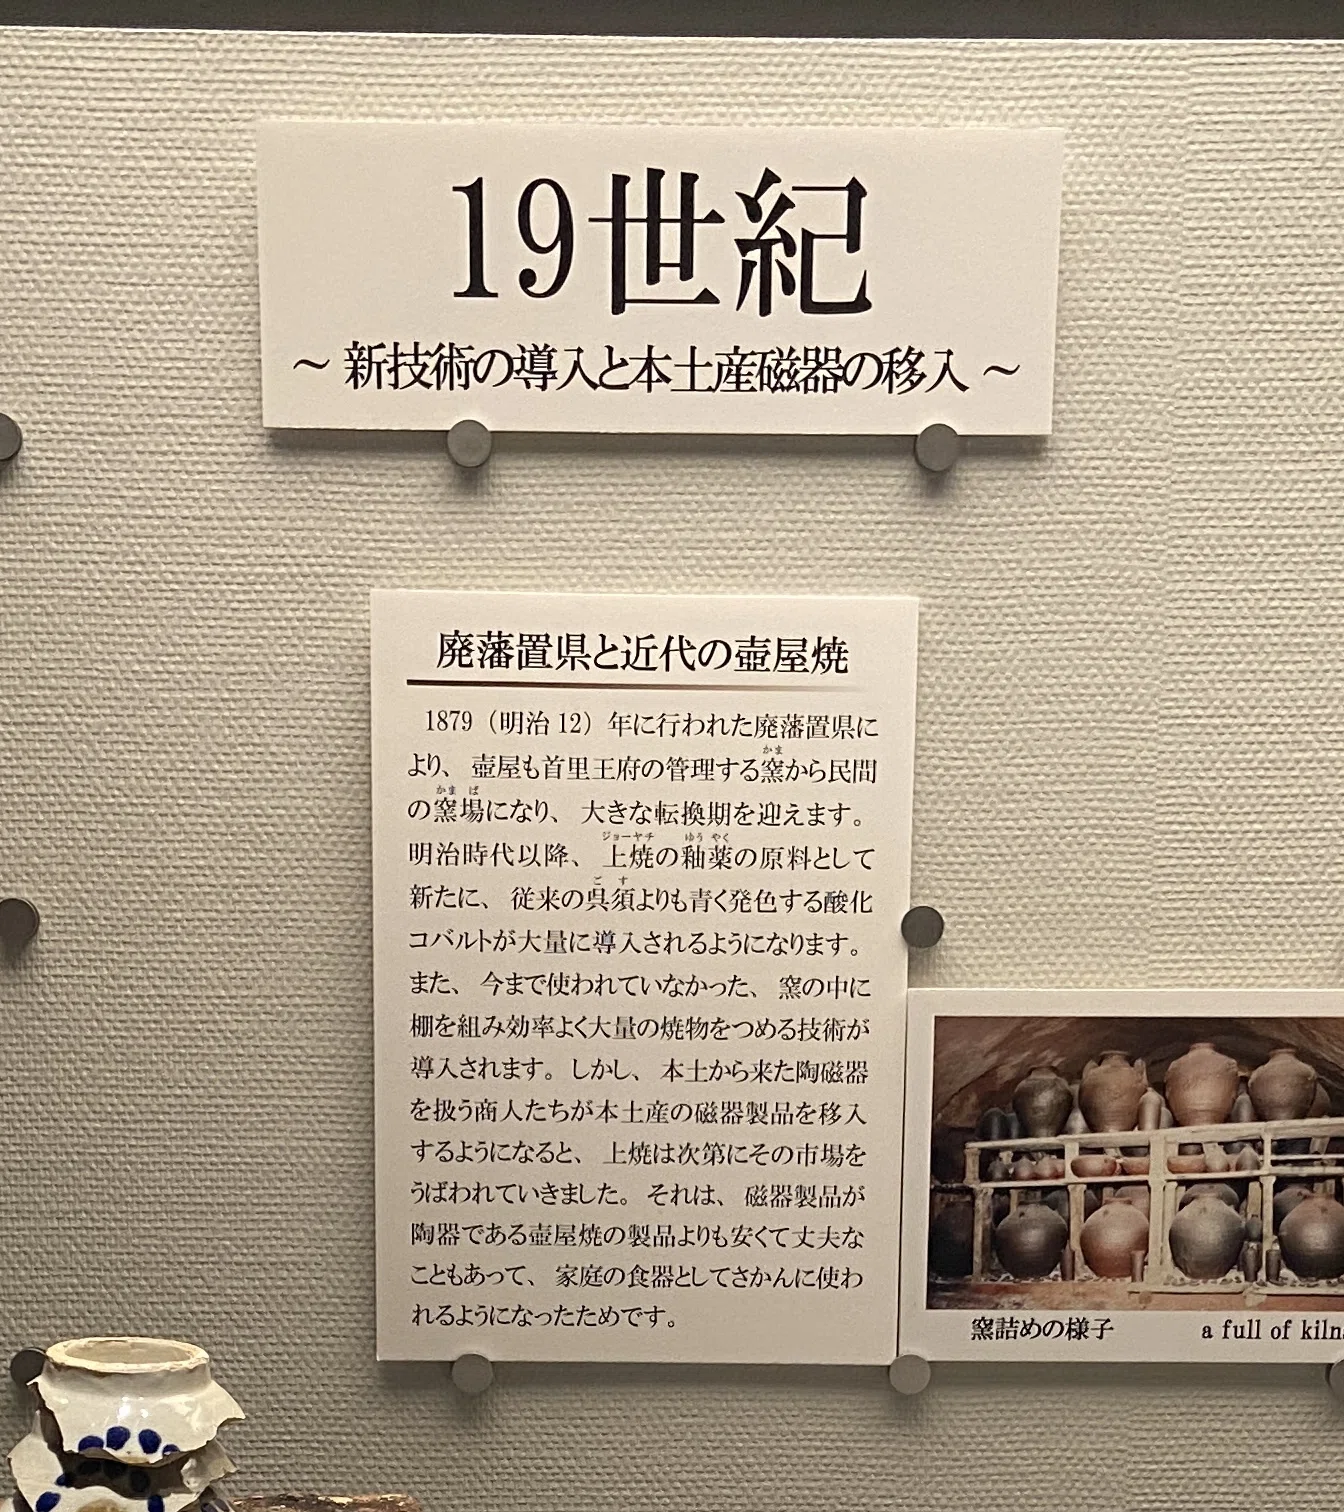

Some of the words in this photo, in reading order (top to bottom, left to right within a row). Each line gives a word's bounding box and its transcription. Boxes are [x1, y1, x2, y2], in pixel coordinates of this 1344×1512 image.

[452, 167, 872, 317] 19世紀
[436, 630, 850, 675] 廃藩置県と近代の壺屋焼
[408, 797, 863, 828] の窯場になり、大きな転換期を迎えます。
[408, 842, 876, 872] 明治時代以降、上焼の釉薬の原料として
[408, 928, 860, 958] コバルトが大量に導入されるようになります。
[409, 1013, 870, 1043] 棚を組み効率よく大量の焼物をつめる技術が
[410, 1097, 868, 1127] を扱う商人たちが本土産の磁器製品を移入
[410, 1139, 867, 1169] するようになると、上焼は次第にその市場を
[410, 1263, 863, 1290] こともあって、家庭の食器としてさかんに使わ
[411, 1303, 676, 1329] れるようになったためです。
[970, 1317, 1114, 1341] 窯詰めの様子
[1201, 1326, 1213, 1340] a
[1222, 1320, 1261, 1340] full
[1270, 1319, 1293, 1340] of
